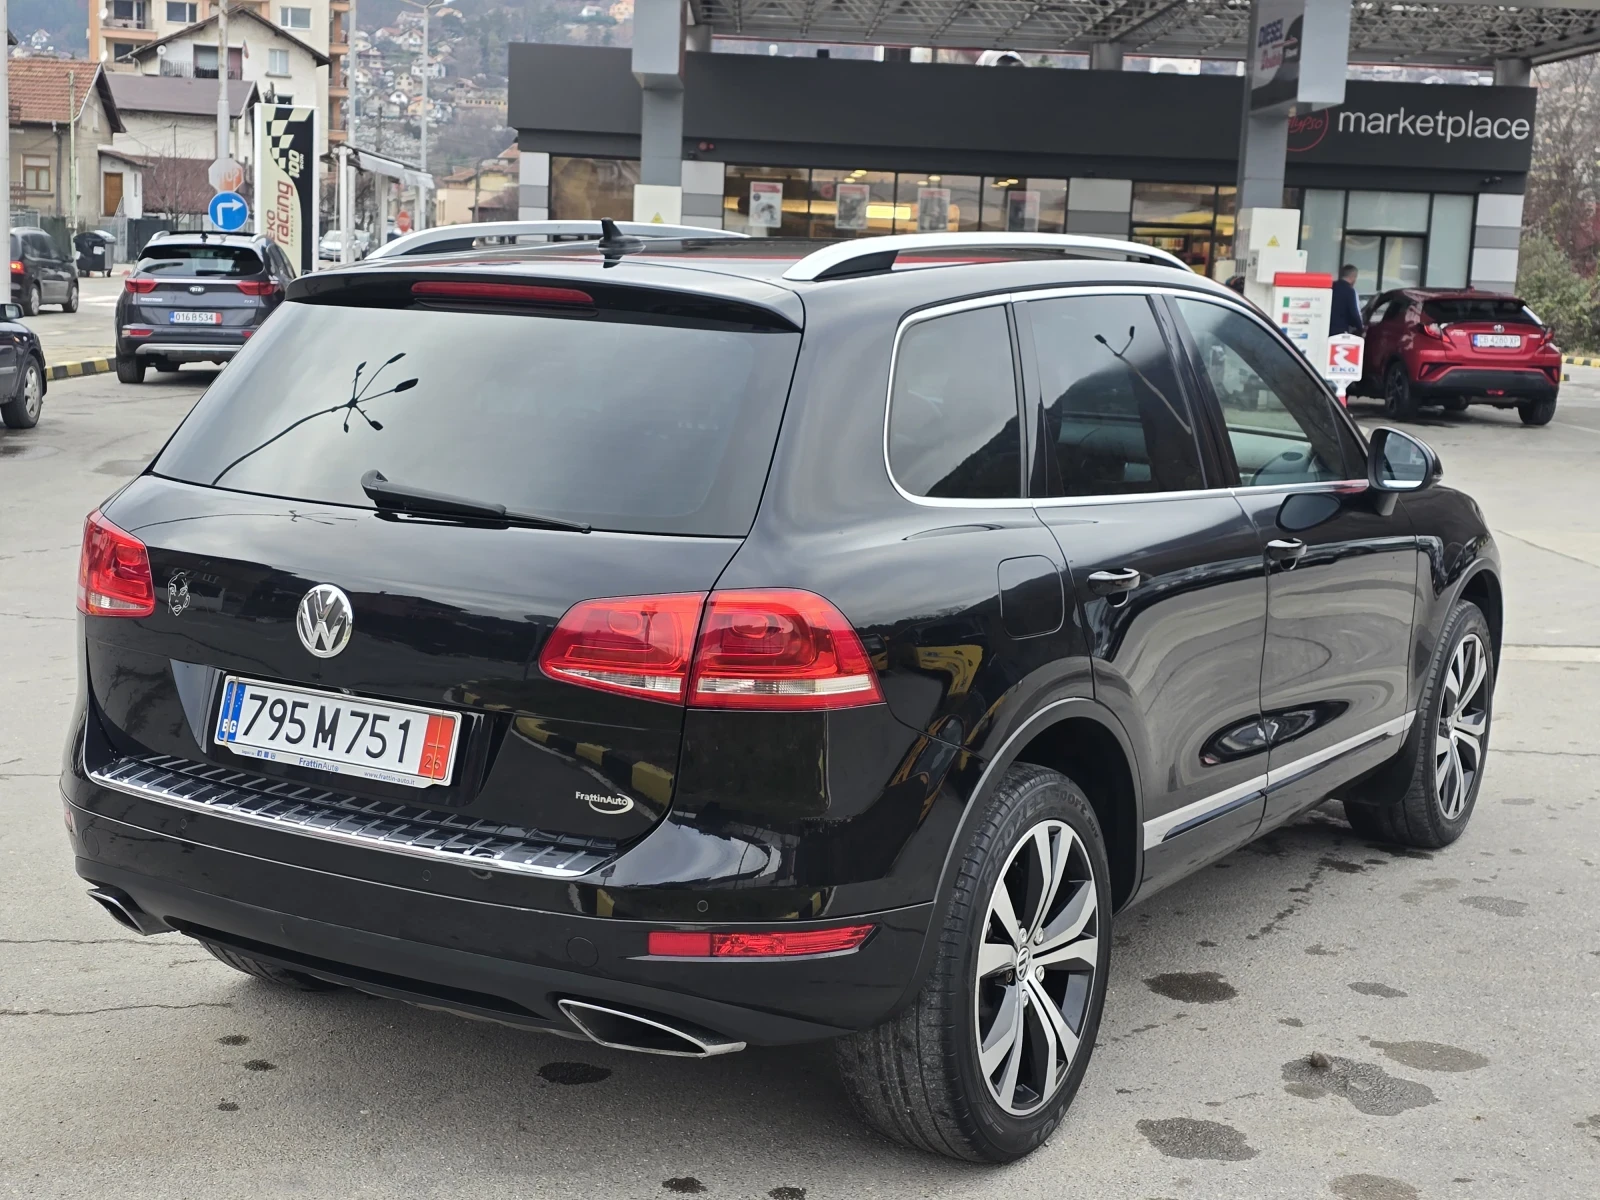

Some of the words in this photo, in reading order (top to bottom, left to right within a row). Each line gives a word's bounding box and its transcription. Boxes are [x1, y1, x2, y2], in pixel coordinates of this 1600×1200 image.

[1338, 107, 1530, 143] marketplace
[288, 149, 300, 178] 100
[266, 209, 276, 241] EKO
[276, 180, 293, 245] racing
[175, 313, 190, 321] 016
[191, 313, 198, 322] B
[198, 314, 213, 322] 534
[243, 693, 309, 745] 795
[313, 705, 341, 751] M
[345, 710, 411, 763] 751
[364, 771, 415, 785] www.frattin-auto.it
[575, 791, 629, 806] FrattinAuto
